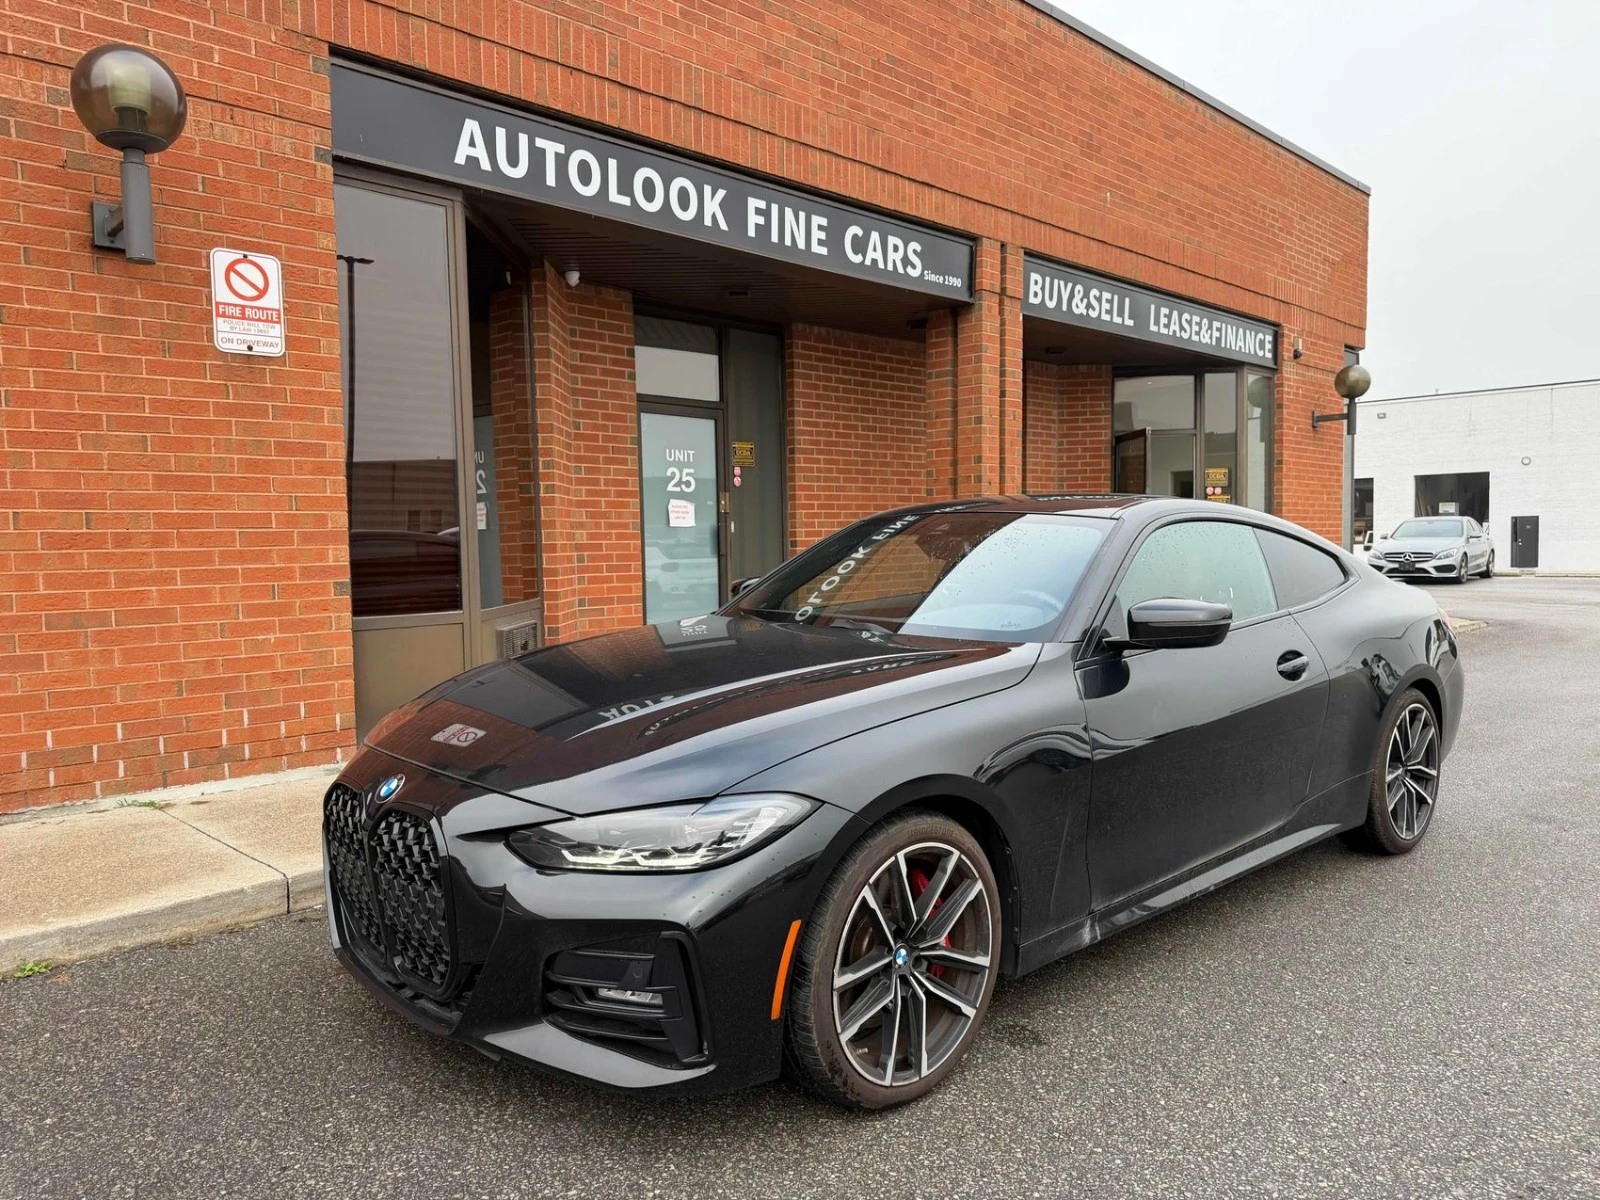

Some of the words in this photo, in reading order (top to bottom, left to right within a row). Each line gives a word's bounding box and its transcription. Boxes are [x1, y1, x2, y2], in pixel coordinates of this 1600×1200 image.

[453, 117, 729, 232] AUTOLOOK
[747, 195, 829, 256] FINE
[844, 225, 923, 278] CARS
[924, 270, 944, 284] Since
[944, 275, 962, 288] 1990
[219, 305, 242, 317] FIRE
[245, 308, 278, 321] ROUTE
[1028, 271, 1135, 327] BUY&SELL
[1149, 303, 1273, 359] LEASE&FINANCE
[223, 319, 246, 327] POLICE
[246, 321, 260, 329] WILL
[236, 338, 279, 348] DRIVEWAY
[666, 448, 695, 463] UNIT
[666, 467, 696, 493] 25
